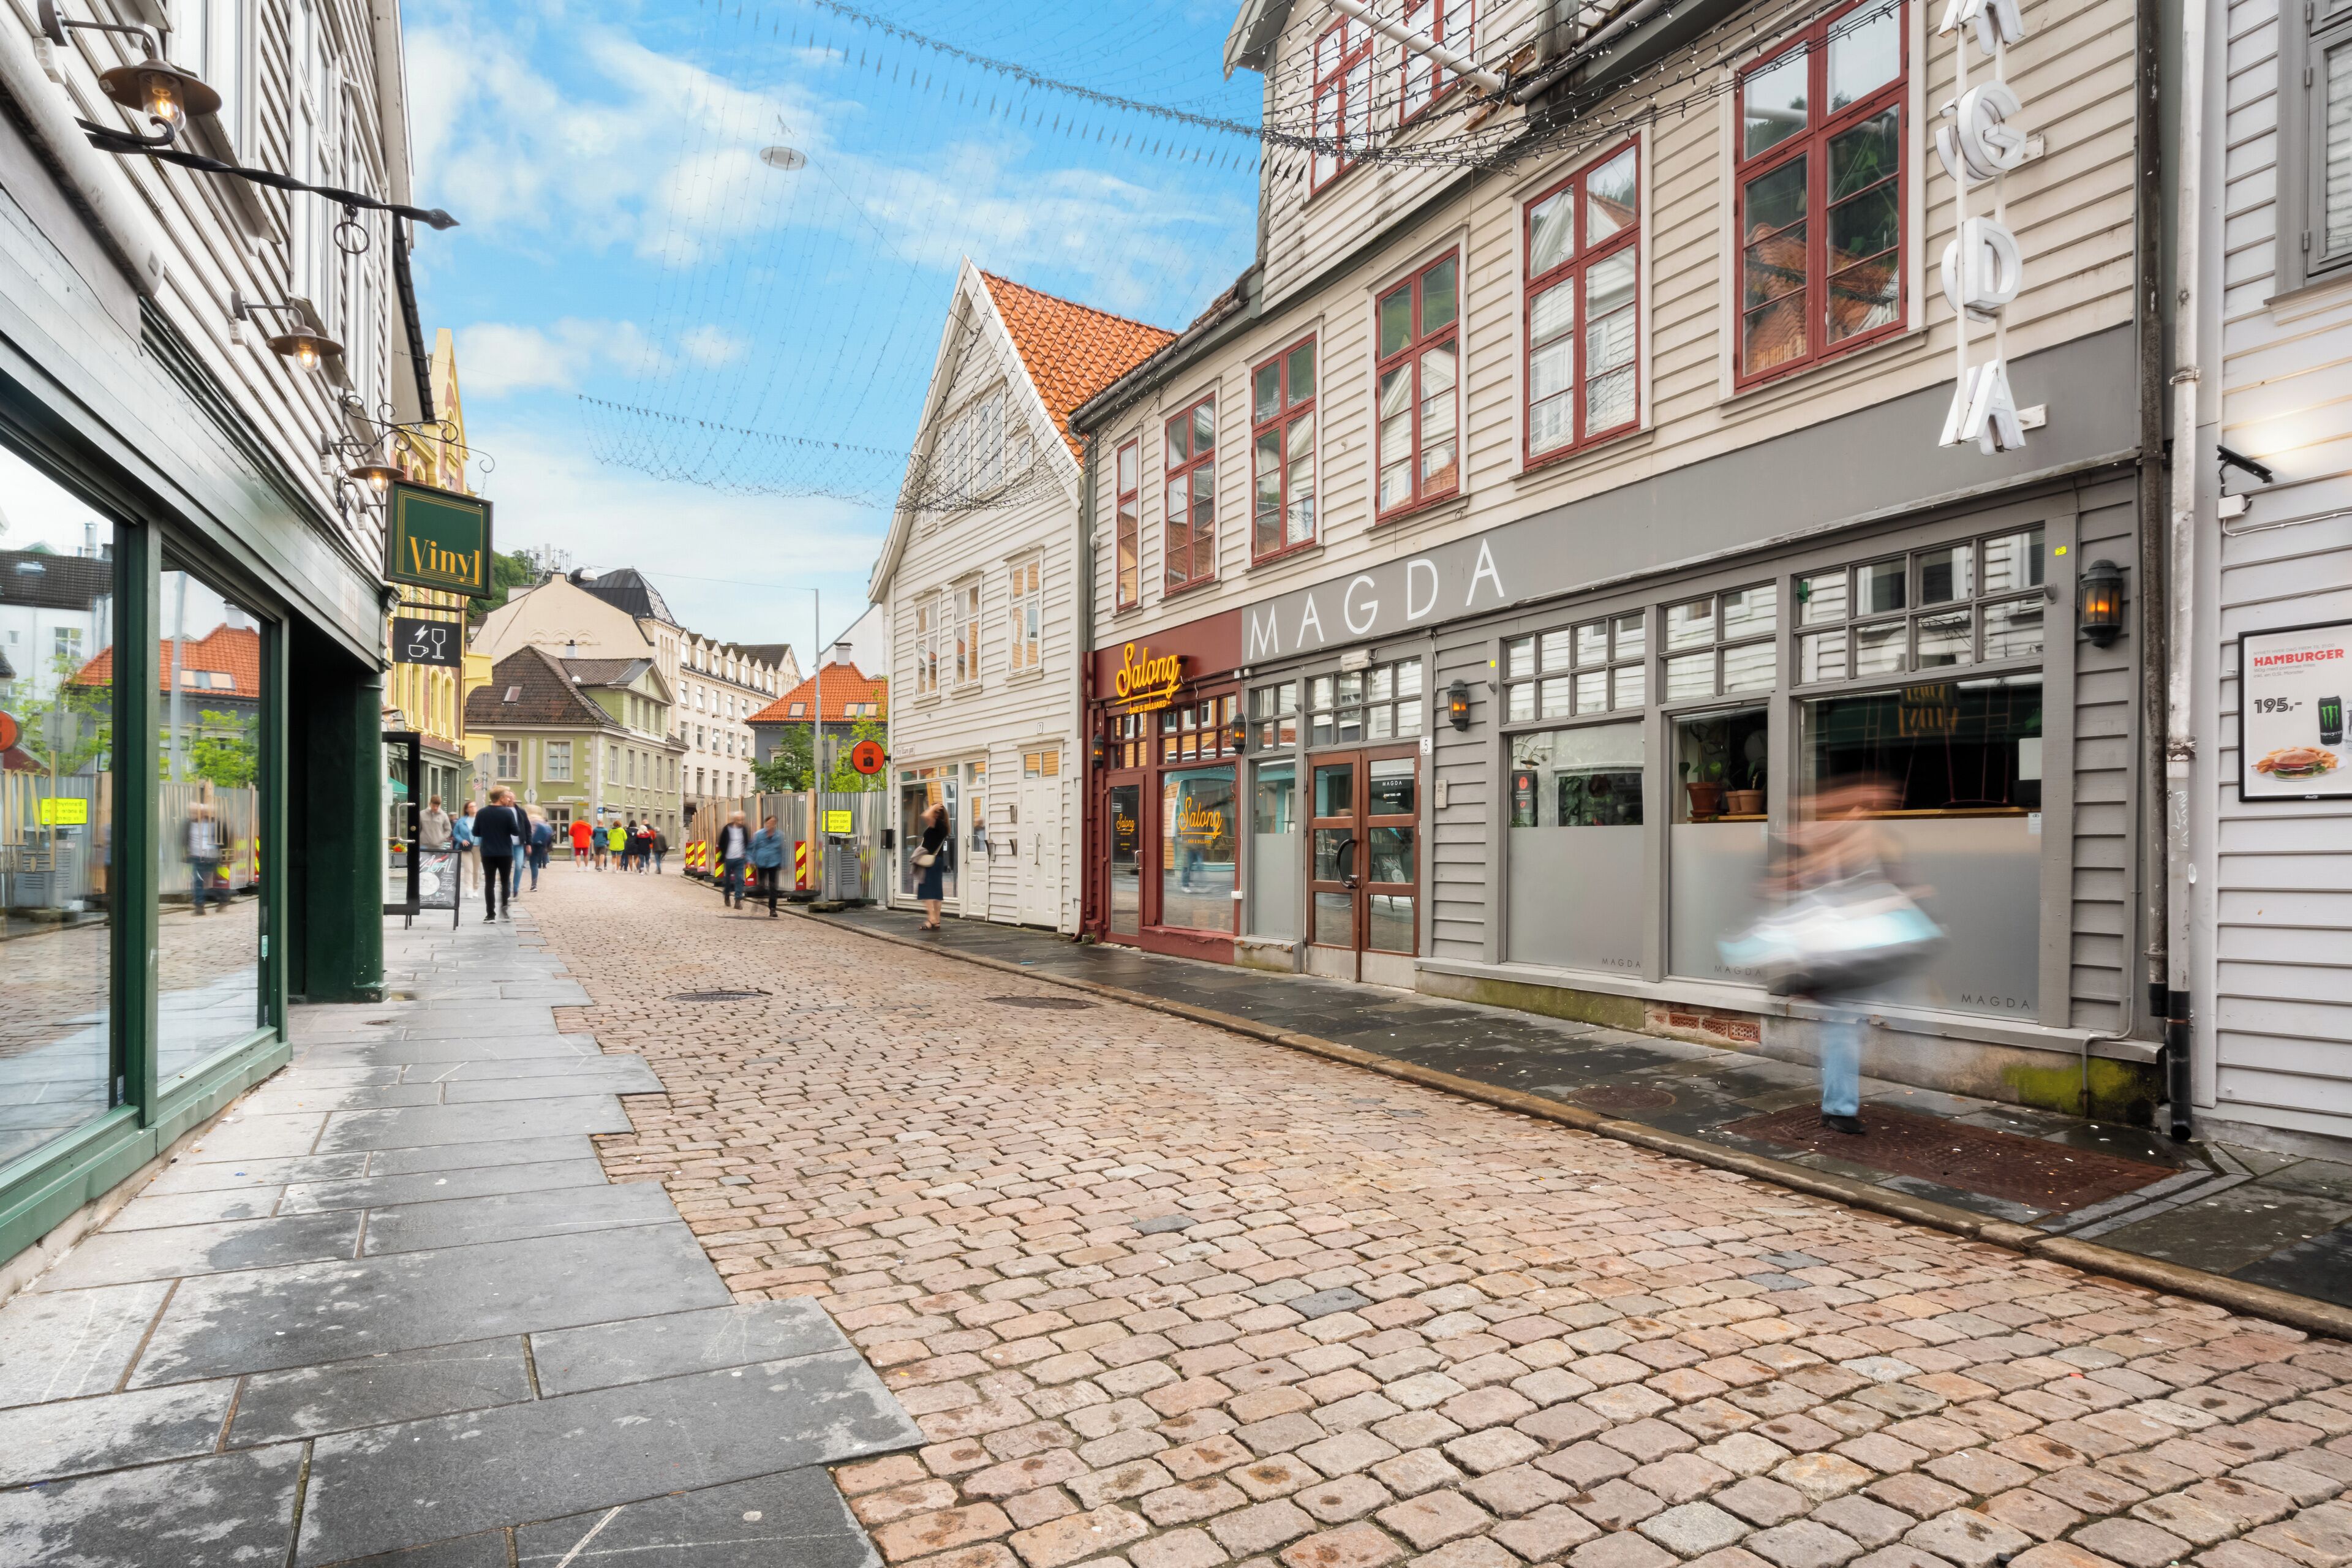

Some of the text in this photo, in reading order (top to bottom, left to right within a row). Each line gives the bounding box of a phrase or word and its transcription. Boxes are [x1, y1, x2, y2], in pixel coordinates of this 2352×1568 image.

[408, 536, 480, 585] Vinyl
[1249, 538, 1505, 660] MAGDA
[2254, 649, 2344, 666] HAMBURGER
[1115, 643, 1182, 702] Salong
[1129, 706, 1139, 714] BAR
[1144, 700, 1167, 711] BILLIARD
[2254, 697, 2302, 714] 195,-
[1424, 739, 1428, 752] 5
[1117, 813, 1135, 833] Salong
[1178, 797, 1223, 839] Salong
[1602, 957, 1641, 968] MAGDA
[1714, 965, 1762, 977] MAGDA
[1961, 993, 2030, 1009] MAGDA
